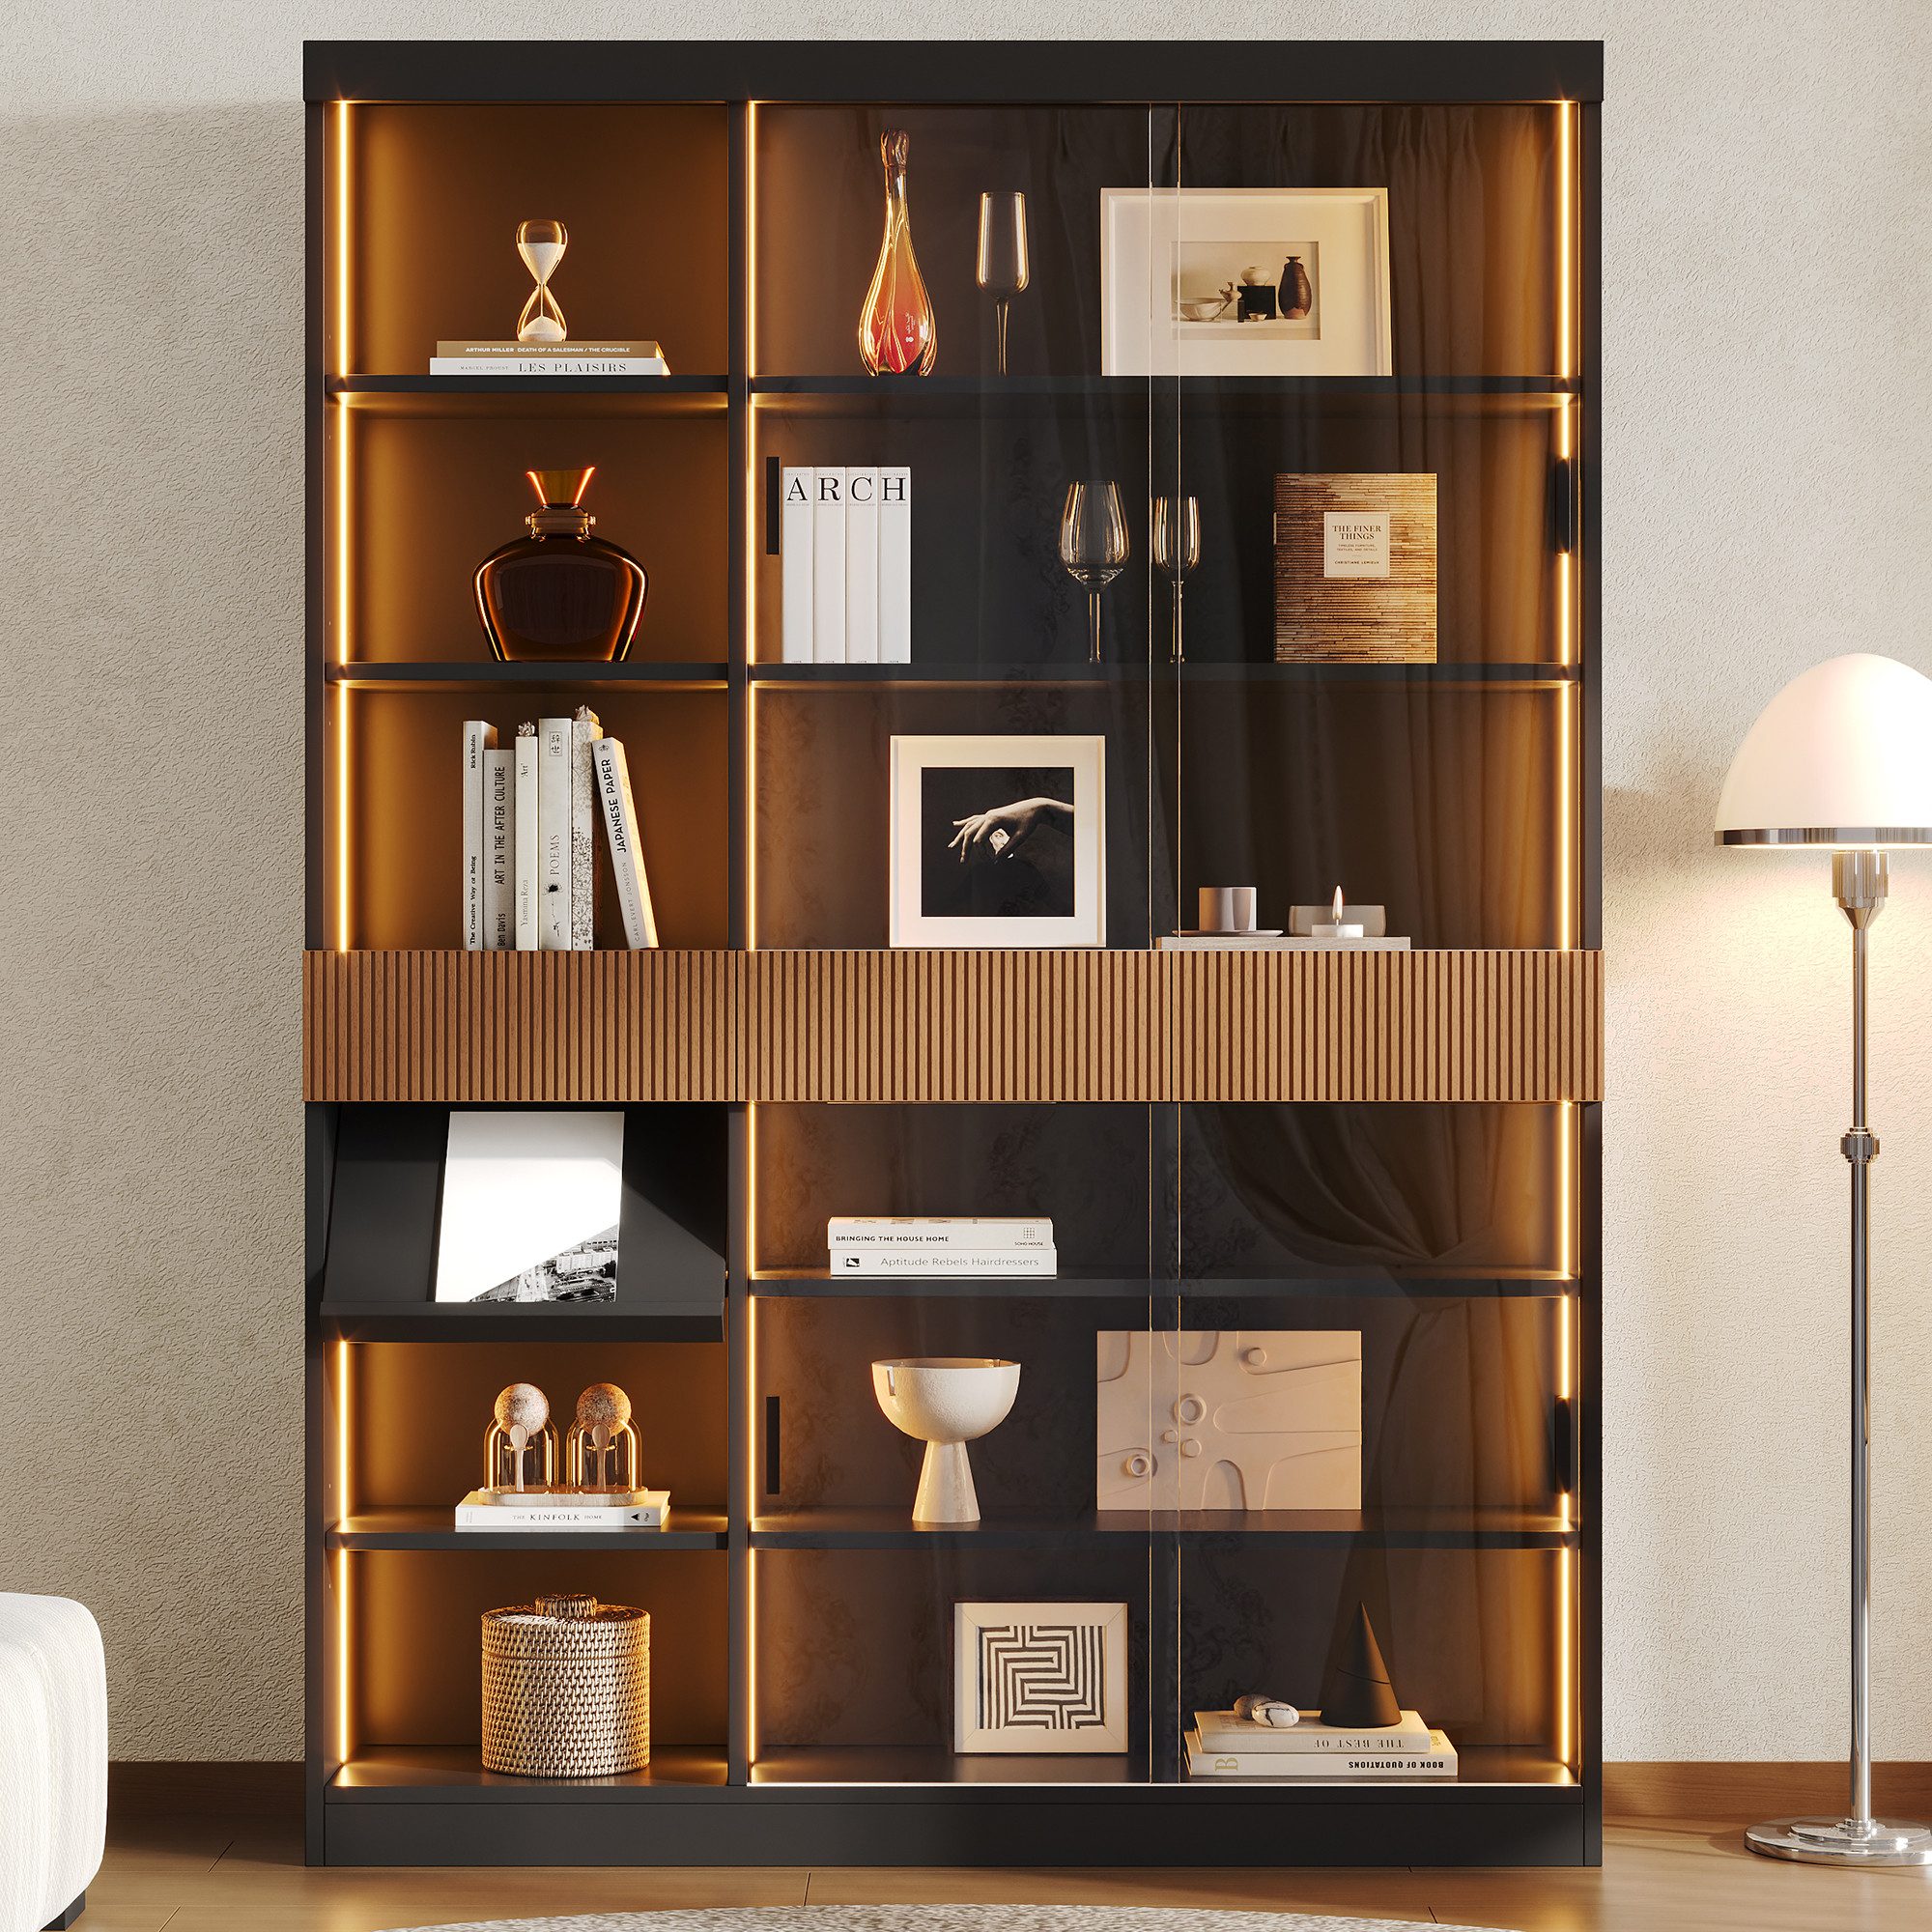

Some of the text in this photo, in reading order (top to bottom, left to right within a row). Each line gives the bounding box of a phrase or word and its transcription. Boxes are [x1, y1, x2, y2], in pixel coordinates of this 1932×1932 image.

[519, 363, 627, 372] LES PLAISIRS
[601, 758, 627, 853] JAPANESE PAPER
[495, 766, 505, 885] ART IN THE AFTER CULTURE
[550, 835, 560, 875] POEMS
[622, 862, 639, 942] CARL-EVERT JONSSON
[496, 913, 506, 931] Davis
[880, 1258, 1039, 1267] Aptitude Rebels Hairdressers
[1314, 1739, 1405, 1748] THE BEST OF
